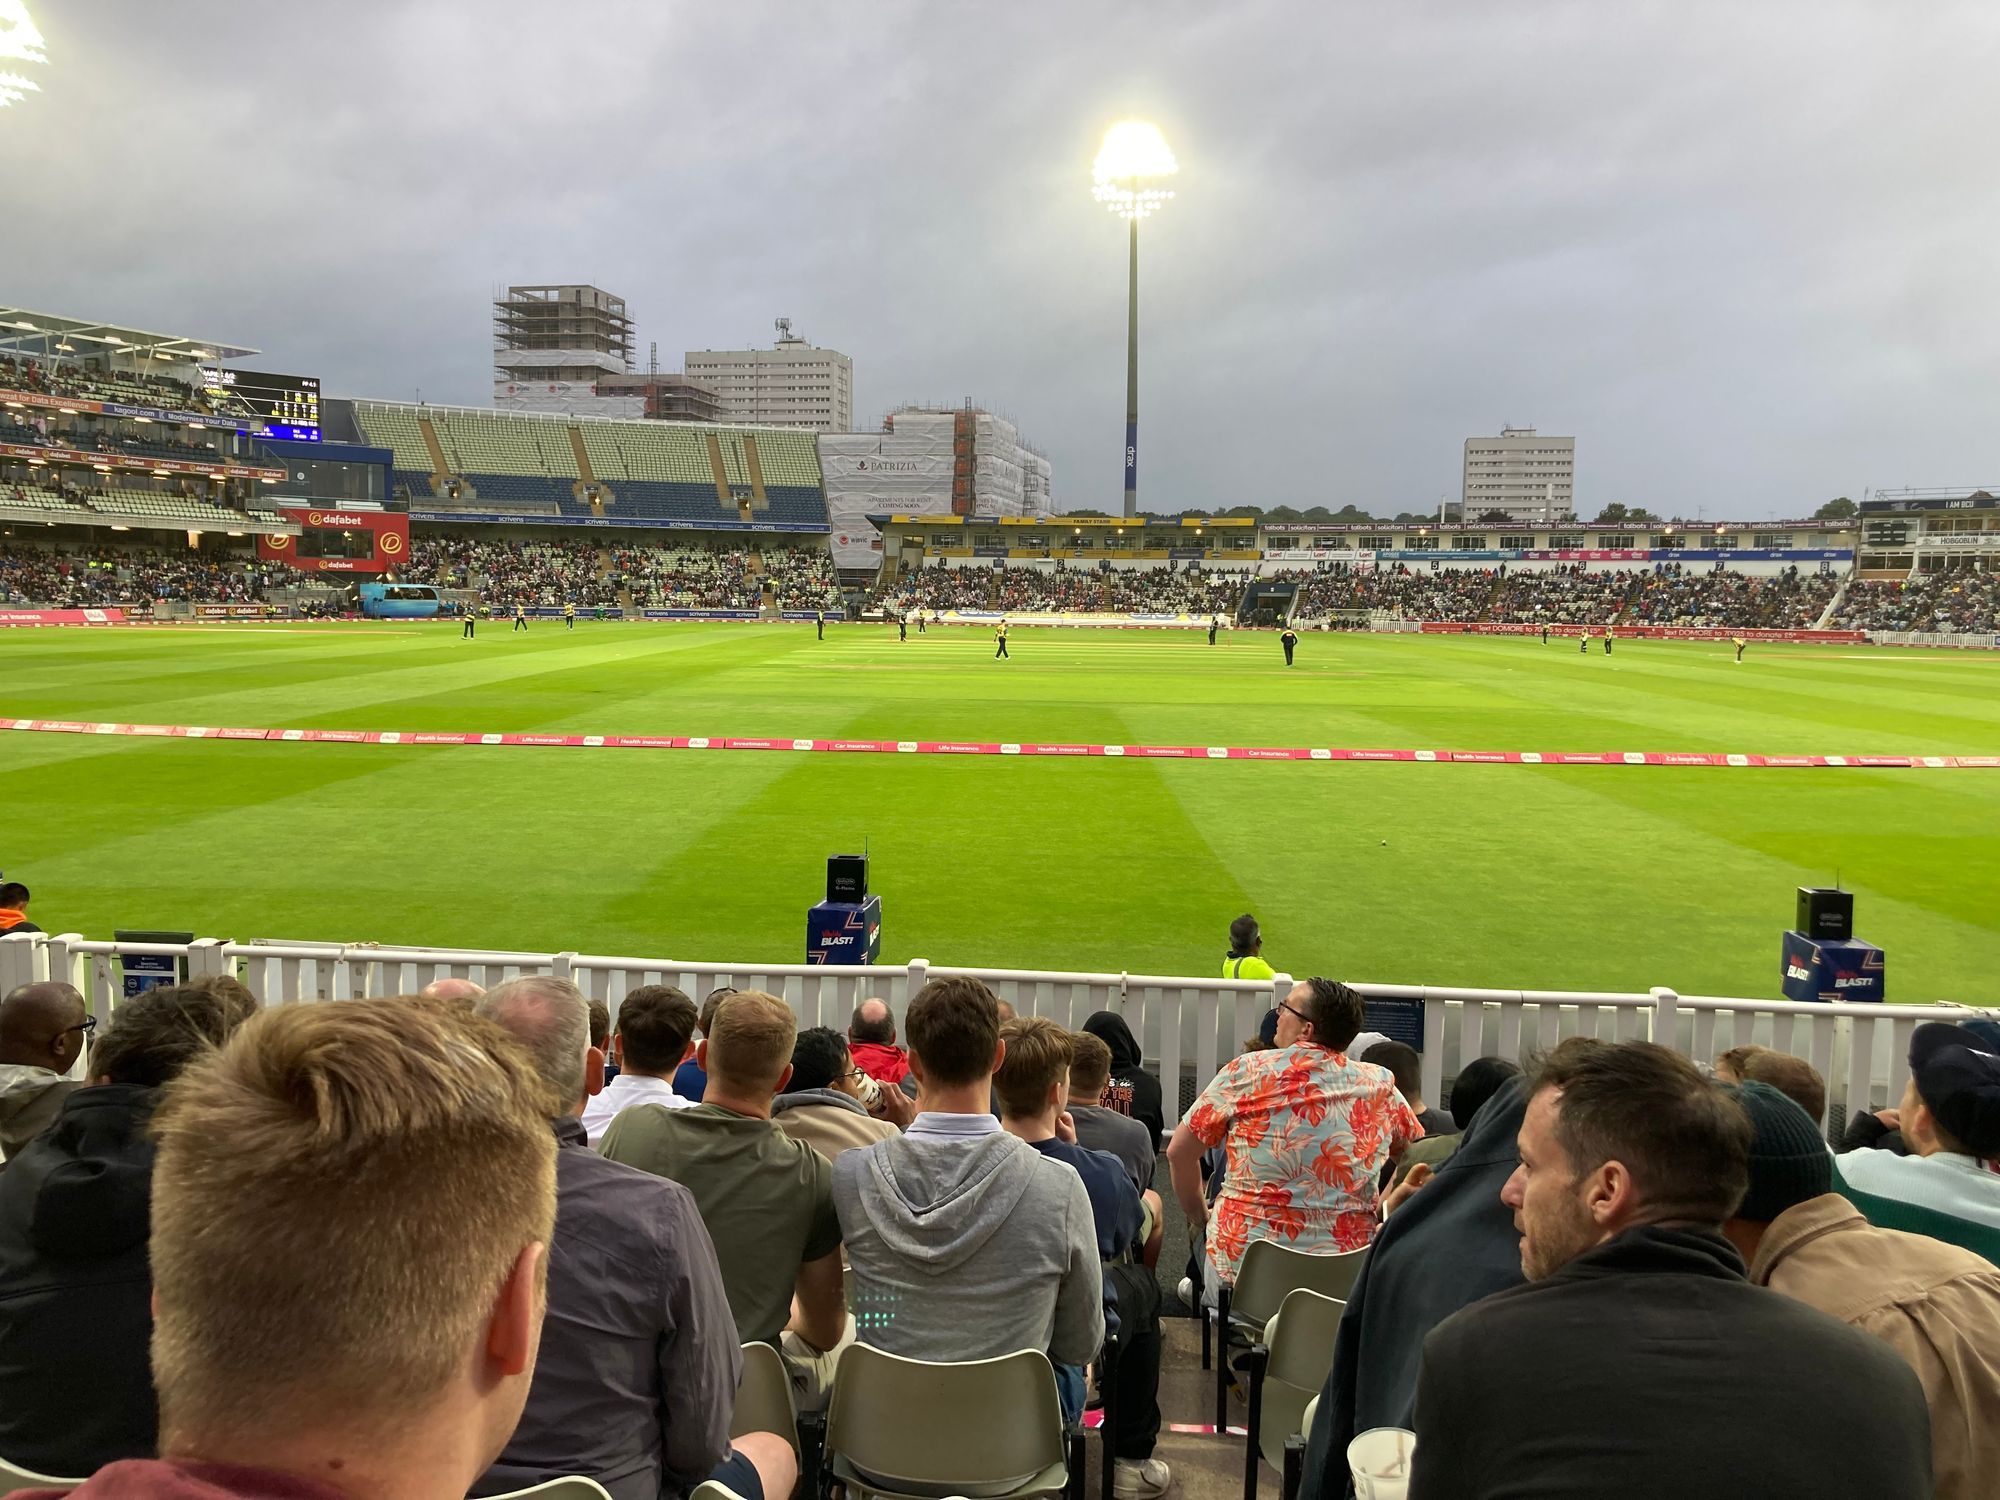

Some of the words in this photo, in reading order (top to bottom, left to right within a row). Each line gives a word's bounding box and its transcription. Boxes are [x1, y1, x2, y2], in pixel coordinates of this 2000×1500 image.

[20, 393, 29, 402] for
[31, 396, 49, 404] Data
[50, 398, 89, 410] Excellence
[113, 406, 155, 417] kagool.com
[168, 413, 204, 423] Modernise
[205, 415, 220, 425] Your
[221, 419, 237, 427] Data
[1127, 446, 1135, 468] drax
[871, 462, 918, 471] PATRIZIA
[322, 514, 362, 526] dafabet
[751, 523, 776, 531] scrivens
[1940, 537, 1978, 545] HOBGOBLIN
[328, 561, 353, 569] dafabet
[1678, 629, 1713, 637] DOMORE
[1755, 631, 1782, 639] donate
[821, 936, 854, 946] BLAST!
[1786, 964, 1809, 981] BLAST!
[1834, 977, 1873, 988] BLAST!
[1111, 1088, 1133, 1102] THE
